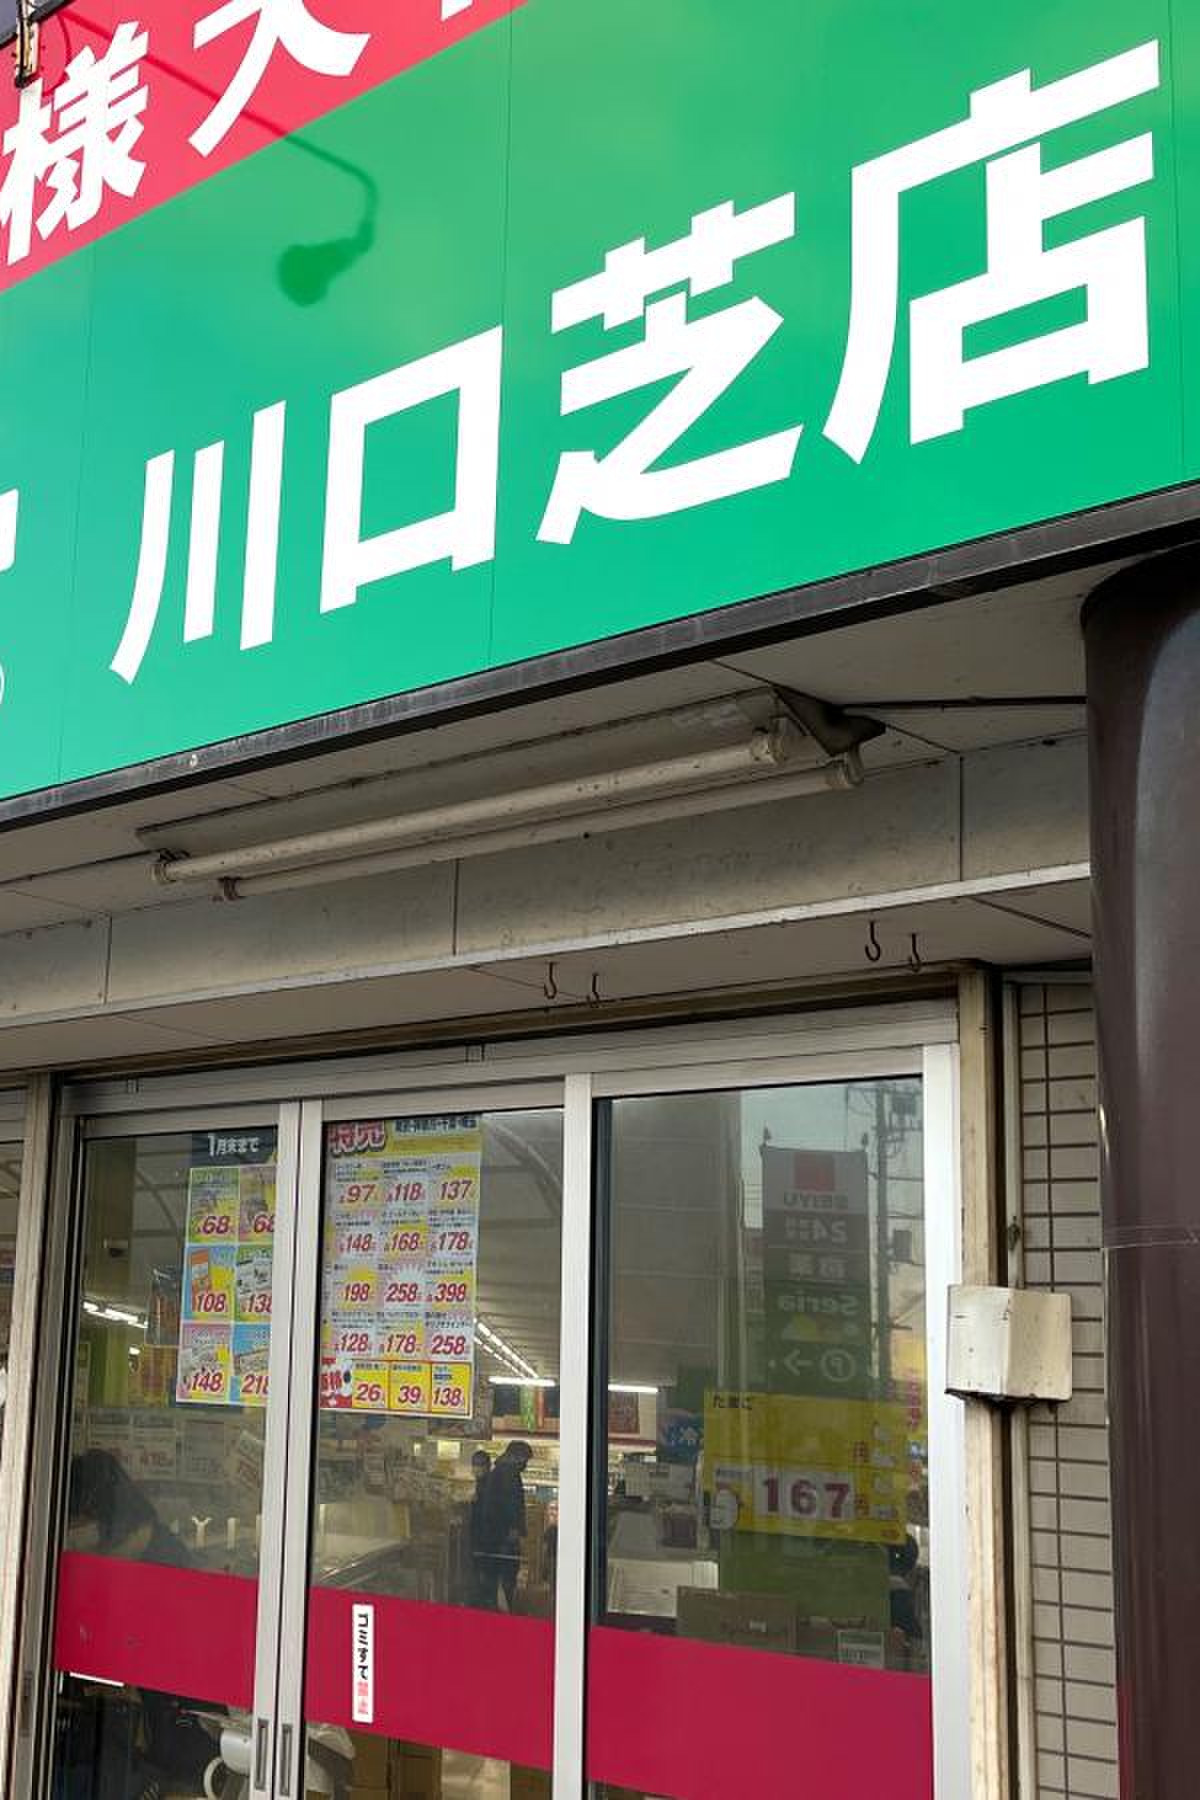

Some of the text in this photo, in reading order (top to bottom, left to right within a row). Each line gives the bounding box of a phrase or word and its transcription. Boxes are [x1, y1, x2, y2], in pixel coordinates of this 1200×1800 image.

[111, 39, 1160, 683] 川口芝店
[347, 1179, 473, 1203] 97 118 137
[202, 1215, 230, 1234] 68
[346, 1231, 470, 1251] 148 168 178
[198, 1292, 227, 1312] 108
[345, 1282, 468, 1302] 198 258 398
[341, 1332, 466, 1355] 128 178 258
[191, 1372, 223, 1393] 148
[354, 1383, 382, 1401] 26
[398, 1385, 422, 1404] 39
[434, 1387, 462, 1407] 138
[762, 1476, 850, 1519] 167
